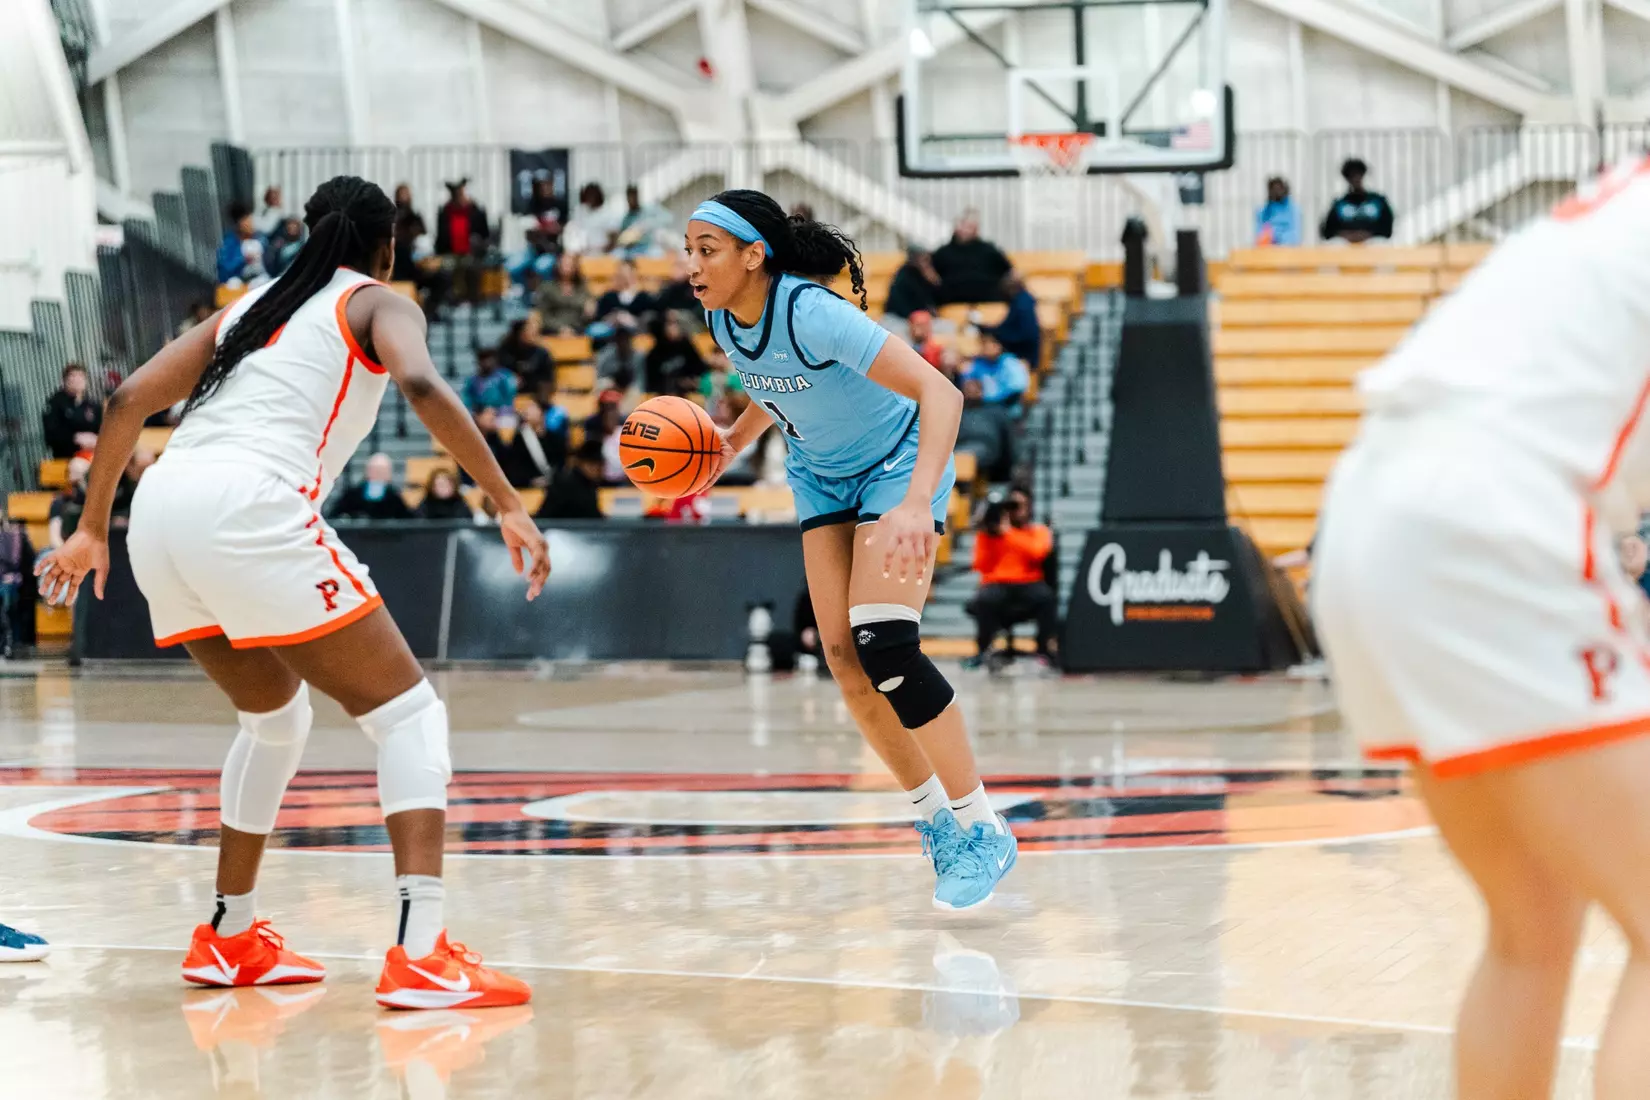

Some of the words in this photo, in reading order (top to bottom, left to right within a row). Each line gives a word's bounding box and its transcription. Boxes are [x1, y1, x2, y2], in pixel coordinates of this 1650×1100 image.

[620, 420, 661, 441] ELITE
[760, 399, 804, 440] 1
[315, 579, 339, 611] P
[1087, 542, 1231, 625] Graduate
